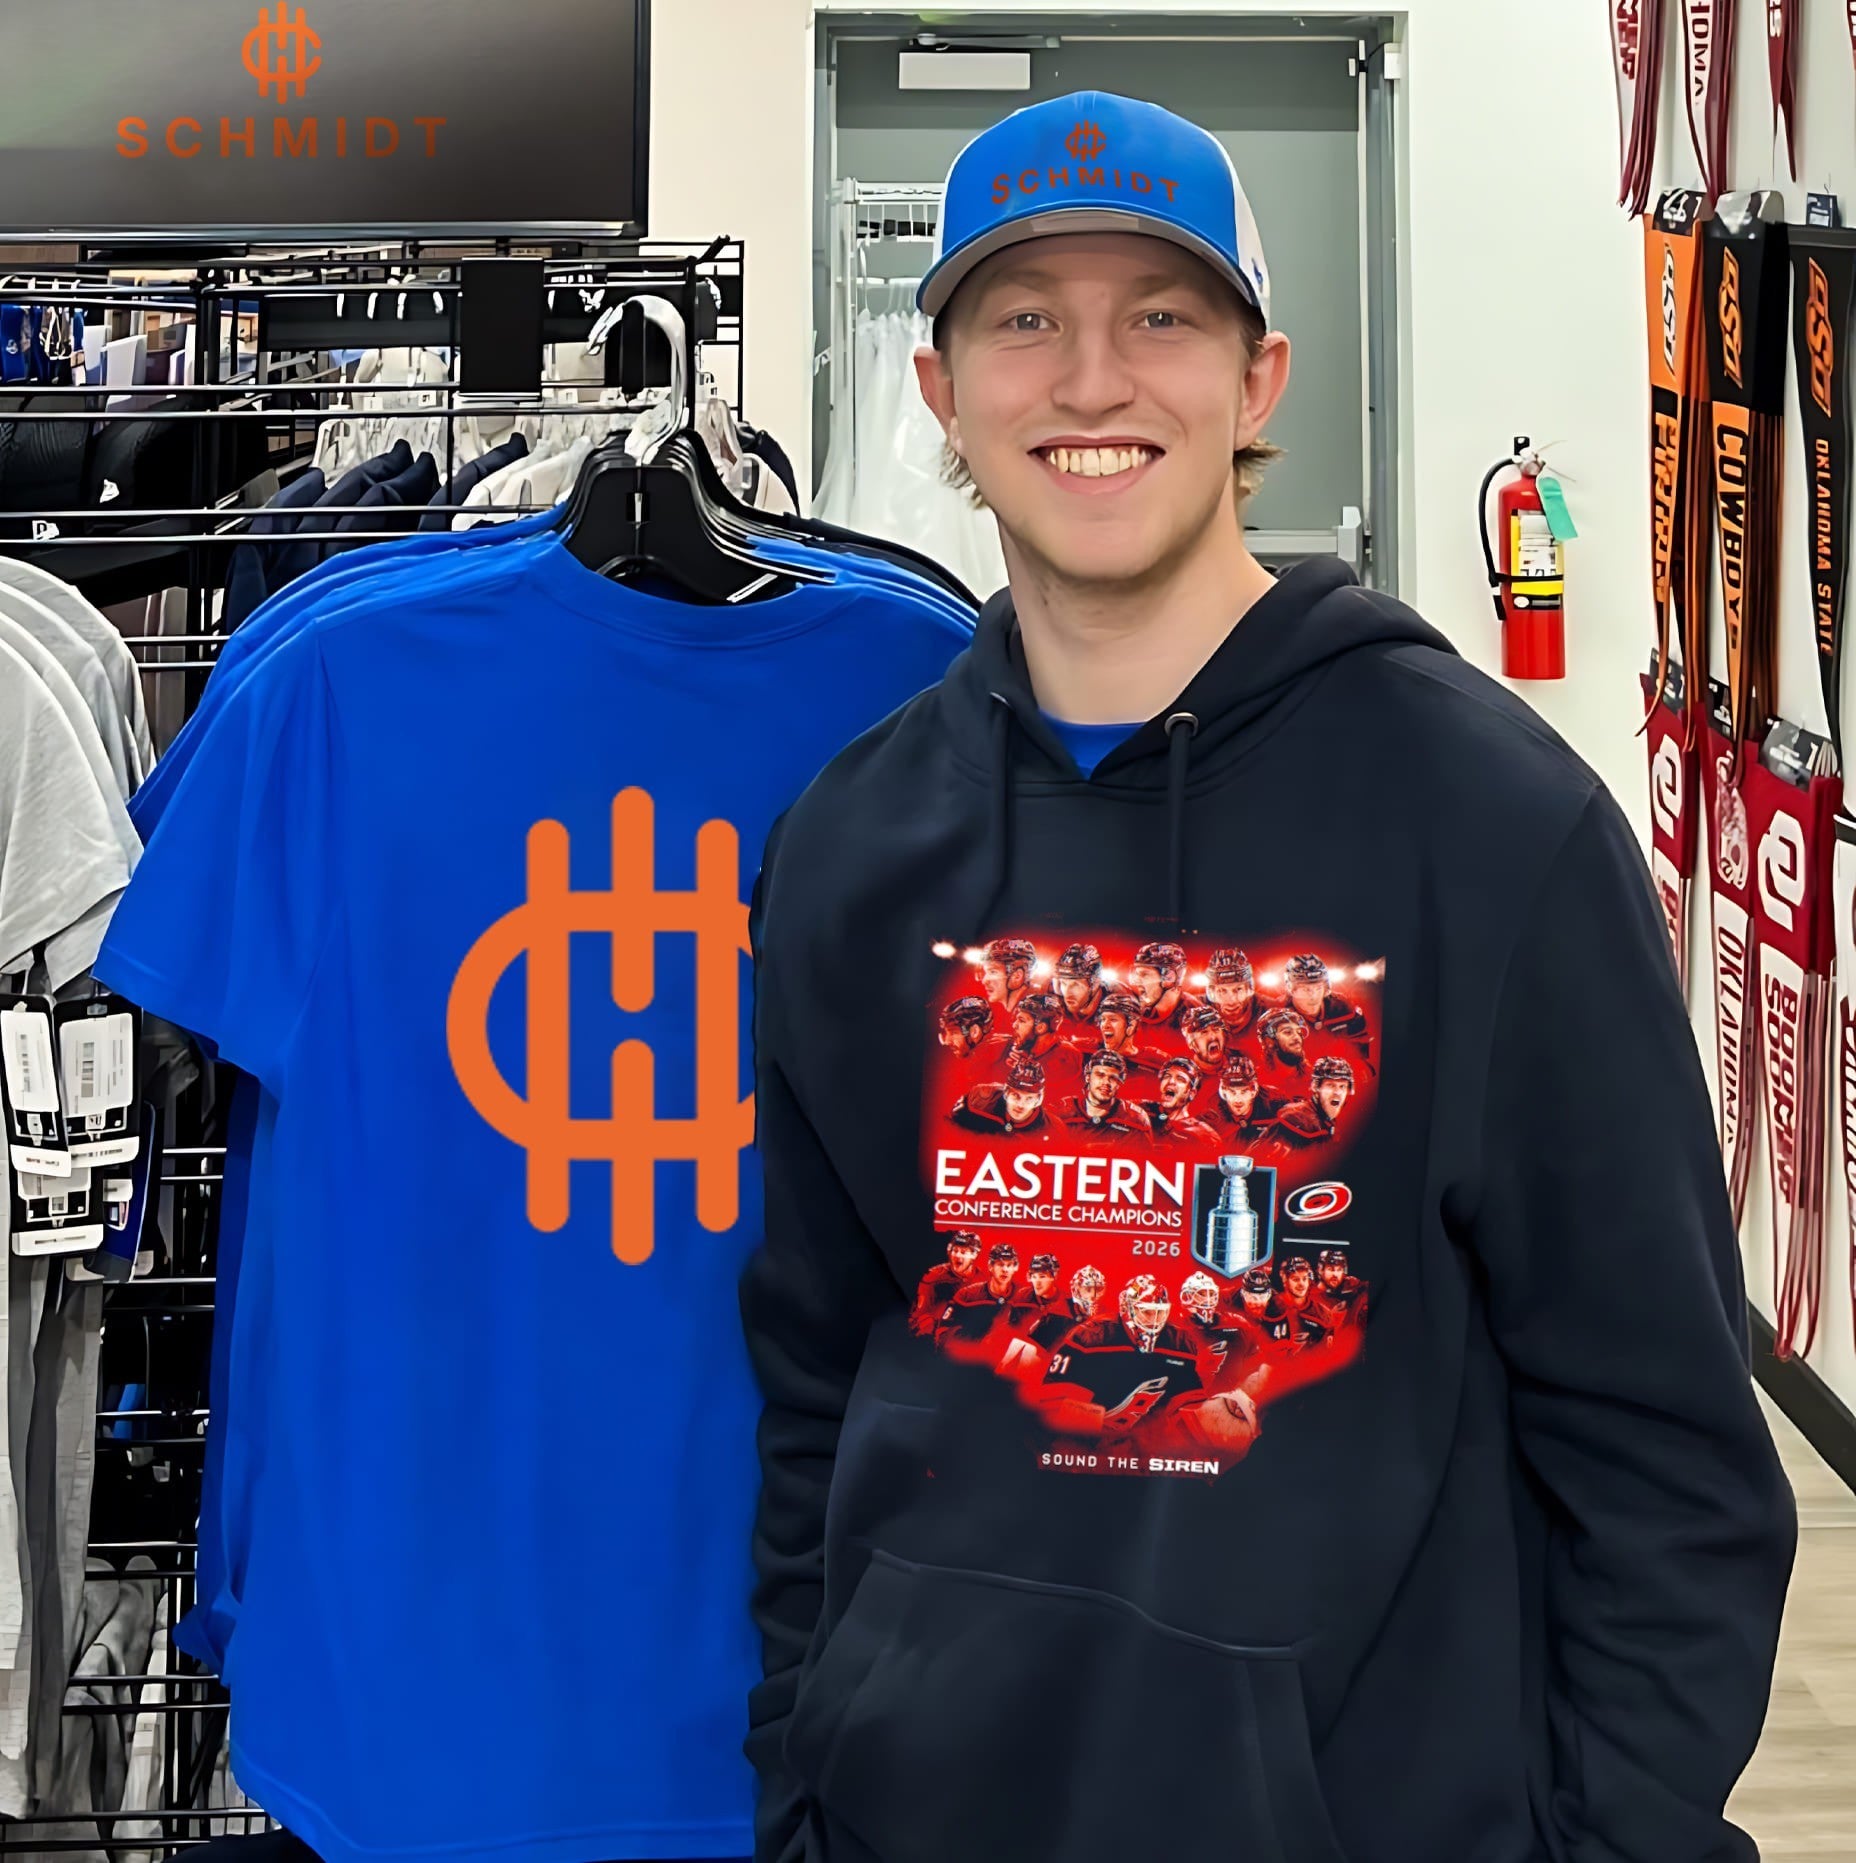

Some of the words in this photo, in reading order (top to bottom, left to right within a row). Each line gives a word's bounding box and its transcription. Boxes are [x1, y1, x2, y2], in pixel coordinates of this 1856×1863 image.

[115, 116, 449, 159] SCHMIDT
[991, 167, 1180, 205] SCHMIDT
[935, 1149, 1185, 1206] EASTERN
[934, 1199, 1063, 1221] CONFERENCE
[1068, 1205, 1182, 1228] CHAMPIONS
[1132, 1240, 1181, 1257] 2026
[1140, 1335, 1158, 1353] 31
[1049, 1355, 1072, 1374] 31
[1042, 1453, 1098, 1467] SOUND
[1107, 1456, 1140, 1469] THE
[1149, 1458, 1219, 1475] SIREN
